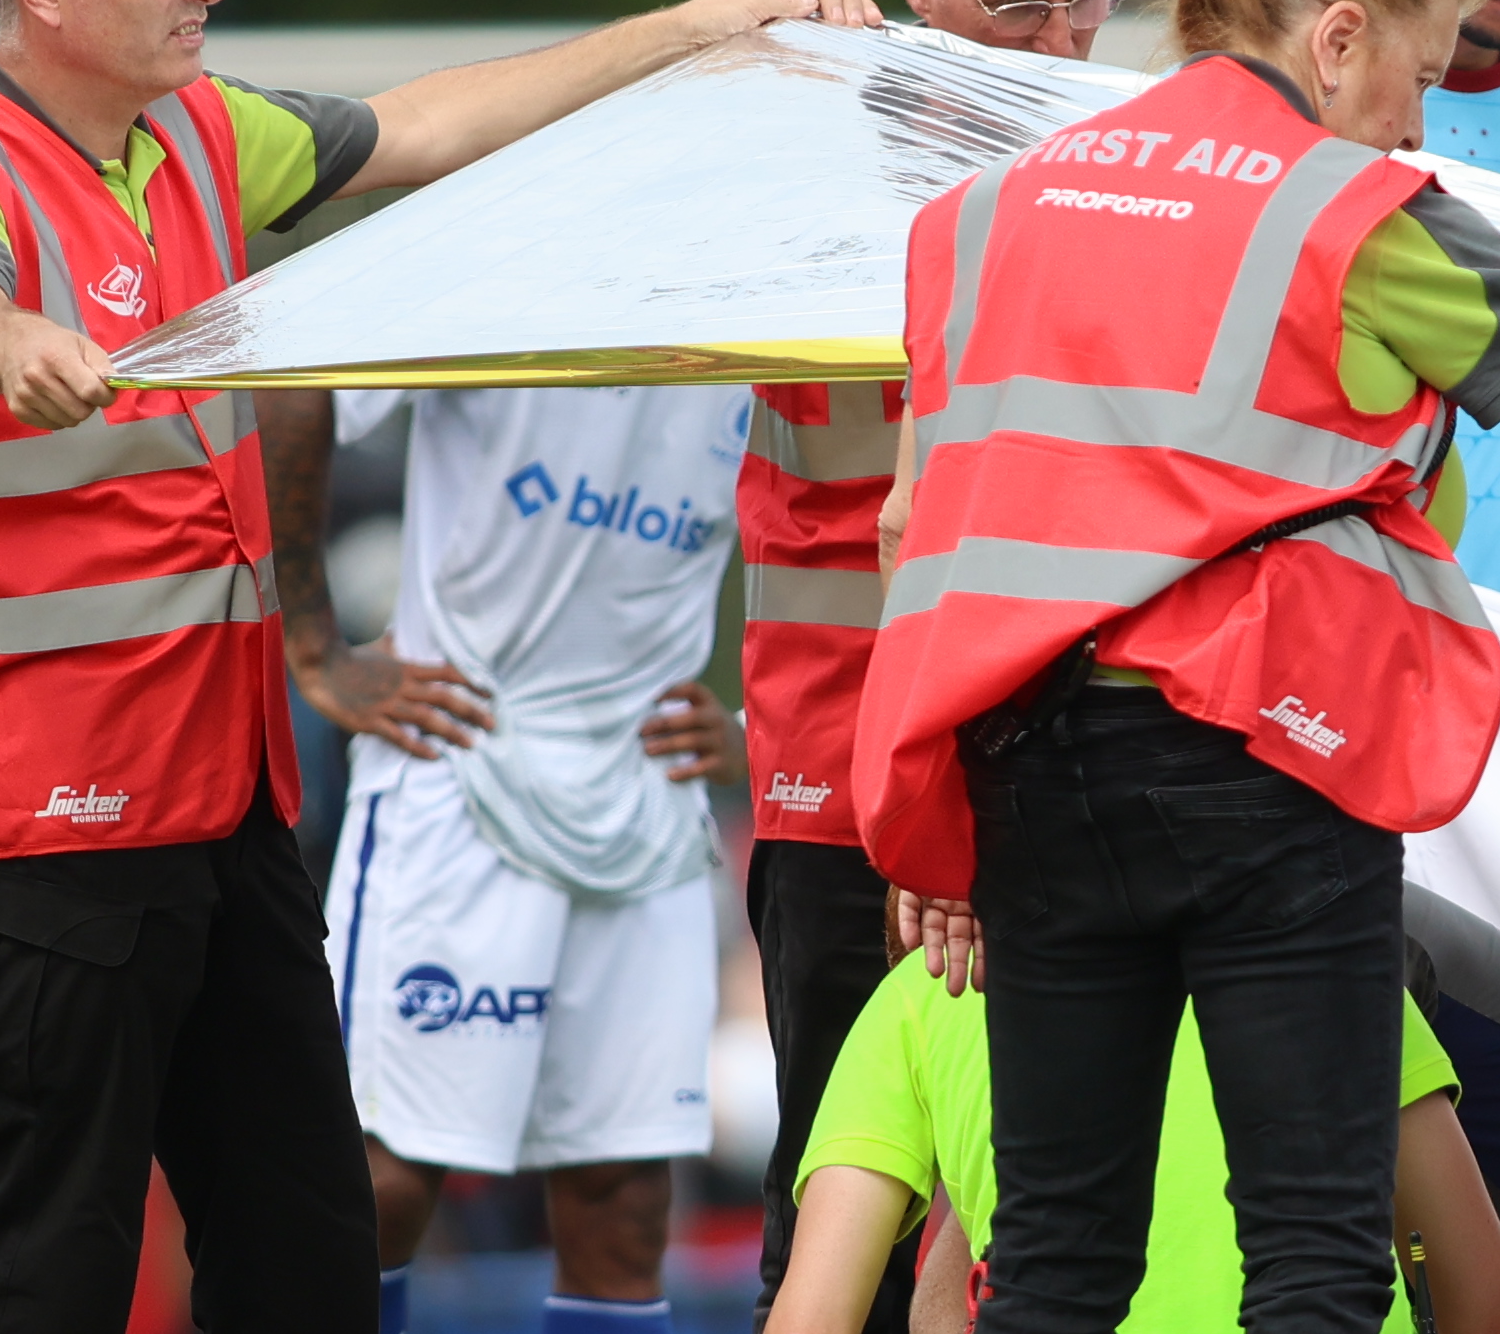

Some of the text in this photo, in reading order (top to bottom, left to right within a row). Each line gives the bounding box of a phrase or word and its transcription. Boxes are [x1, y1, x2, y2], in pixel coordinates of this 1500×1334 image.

[1014, 128, 1283, 185] FIRST AID
[1035, 187, 1195, 220] PROFORTO
[1258, 695, 1348, 750] Snickers
[34, 783, 131, 818] Snickers
[70, 813, 121, 824] WORKWEAR
